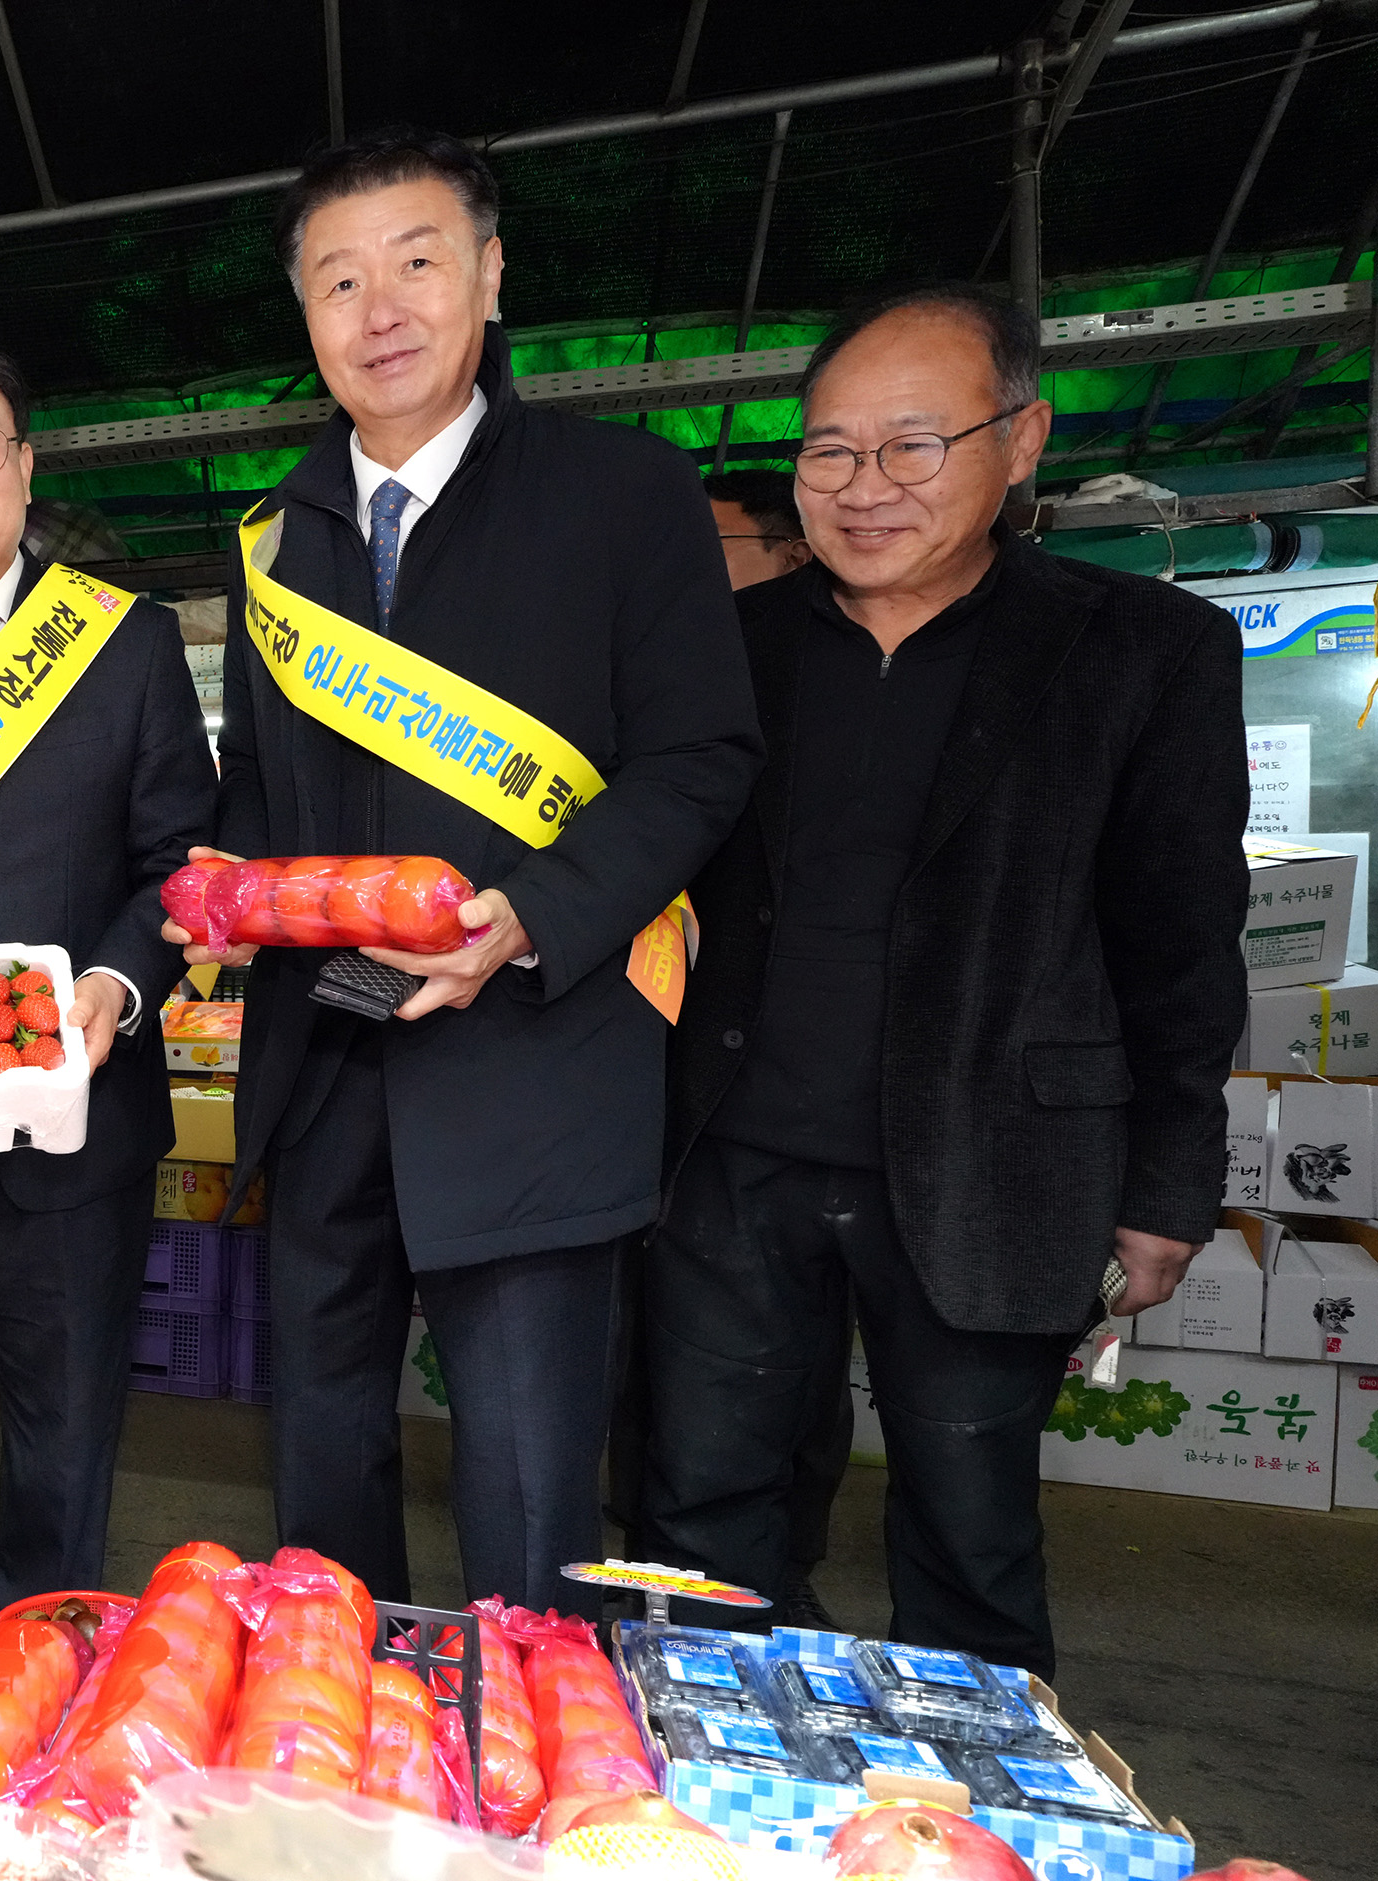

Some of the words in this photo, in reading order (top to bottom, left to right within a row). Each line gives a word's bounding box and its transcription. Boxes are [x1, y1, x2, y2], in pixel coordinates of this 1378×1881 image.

[1225, 603, 1281, 630] UCK
[304, 644, 543, 801] 온누리상품권을
[1280, 884, 1333, 904] 숙주나물
[1287, 1033, 1371, 1054] 숙주나물
[1247, 1134, 1263, 1143] 2kg
[1240, 1165, 1261, 1200] 버섯
[1206, 1390, 1317, 1442] 봄동
[1184, 1449, 1229, 1466] 우수한
[667, 1641, 712, 1655] collipulli
